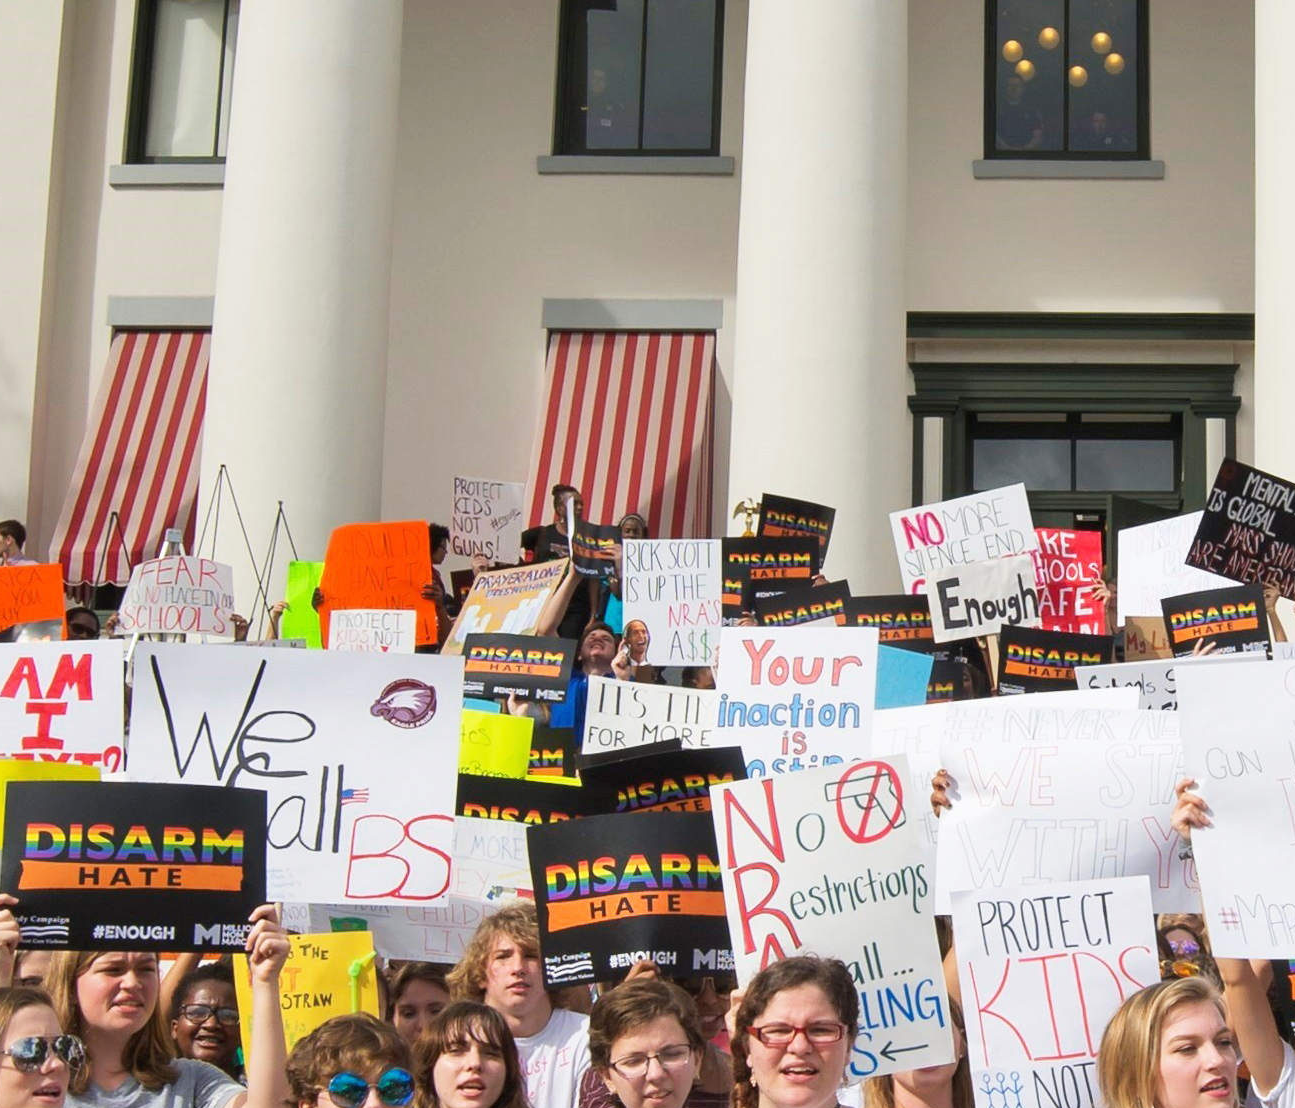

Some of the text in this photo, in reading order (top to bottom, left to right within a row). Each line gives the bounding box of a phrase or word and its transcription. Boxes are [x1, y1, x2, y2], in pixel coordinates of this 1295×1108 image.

[454, 477, 504, 498] PROTECT
[1243, 471, 1295, 513] MENTAL
[454, 497, 492, 517] KIDS
[1208, 487, 1276, 538] IS GLOBAL
[452, 517, 481, 534] NOT
[901, 497, 1010, 550] NO MORE
[452, 537, 500, 560] GUNS!
[626, 541, 715, 573] RICK SCOTT
[985, 530, 1025, 559] END
[1188, 539, 1226, 566] ARE
[139, 556, 222, 590] FEAR
[626, 574, 707, 603] IS UP THE
[936, 573, 1039, 630] Enough
[121, 604, 227, 634] SCHOOLS
[337, 612, 404, 630] PROTECT
[668, 599, 722, 628] NRA'S
[1170, 602, 1258, 631] DISARM
[1192, 622, 1236, 637] HATE
[470, 646, 564, 666] DISARM
[490, 663, 534, 673] HATE
[742, 639, 863, 686] Your
[1008, 645, 1101, 668] DISARM
[0, 653, 94, 701] AM
[1027, 666, 1074, 679] HATE
[598, 683, 648, 718] IT'S
[717, 693, 860, 728] inaction
[21, 702, 69, 750] I
[588, 723, 712, 747] FOR MORE
[963, 746, 1058, 807] WE
[1205, 746, 1263, 781] GUN
[25, 822, 245, 864] DISARM
[345, 814, 454, 900] BS
[956, 817, 1129, 888] WITH
[78, 866, 183, 887] HATE
[545, 853, 723, 901] DISARM
[589, 894, 682, 920] HATE
[732, 861, 929, 954] Restrictions
[92, 924, 176, 940] #ENOUGH
[976, 891, 1114, 957] PROTECT
[300, 944, 329, 961] THE
[281, 992, 333, 1010] STRAW
